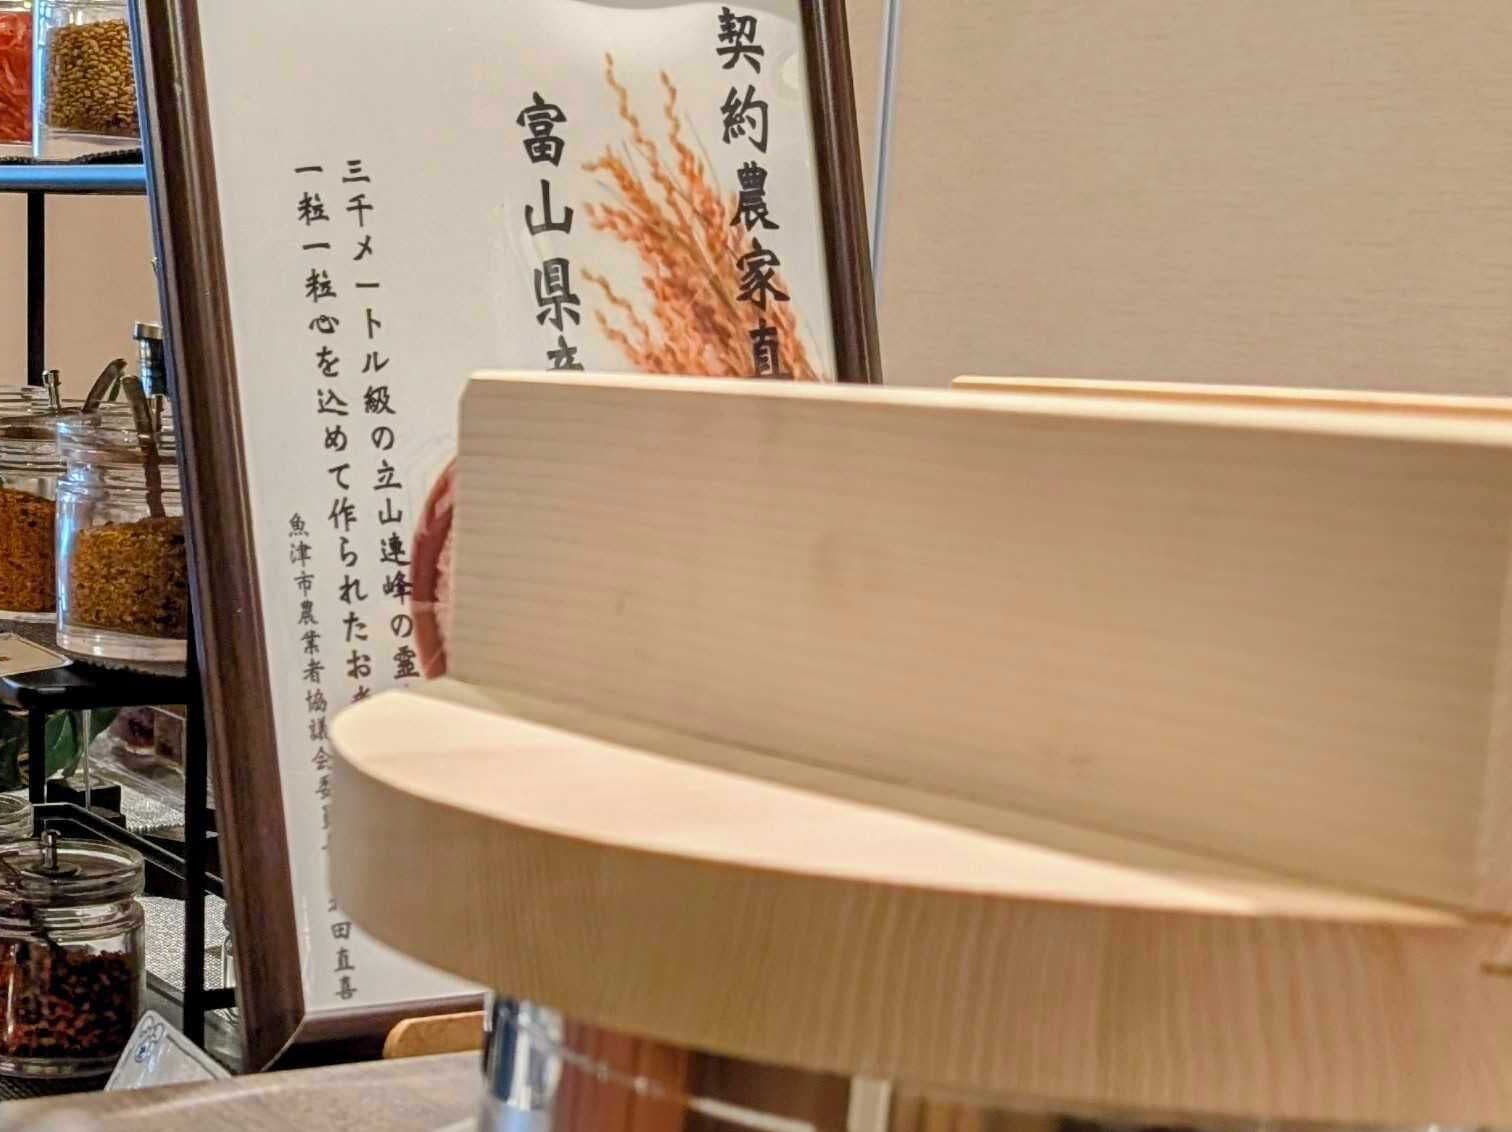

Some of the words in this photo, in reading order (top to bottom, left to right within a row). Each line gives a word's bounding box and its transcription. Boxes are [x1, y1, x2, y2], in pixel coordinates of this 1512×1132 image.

[716, 6, 794, 379] 契約農家直
[342, 159, 420, 688] 三千メートル級の立山連峰の霊
